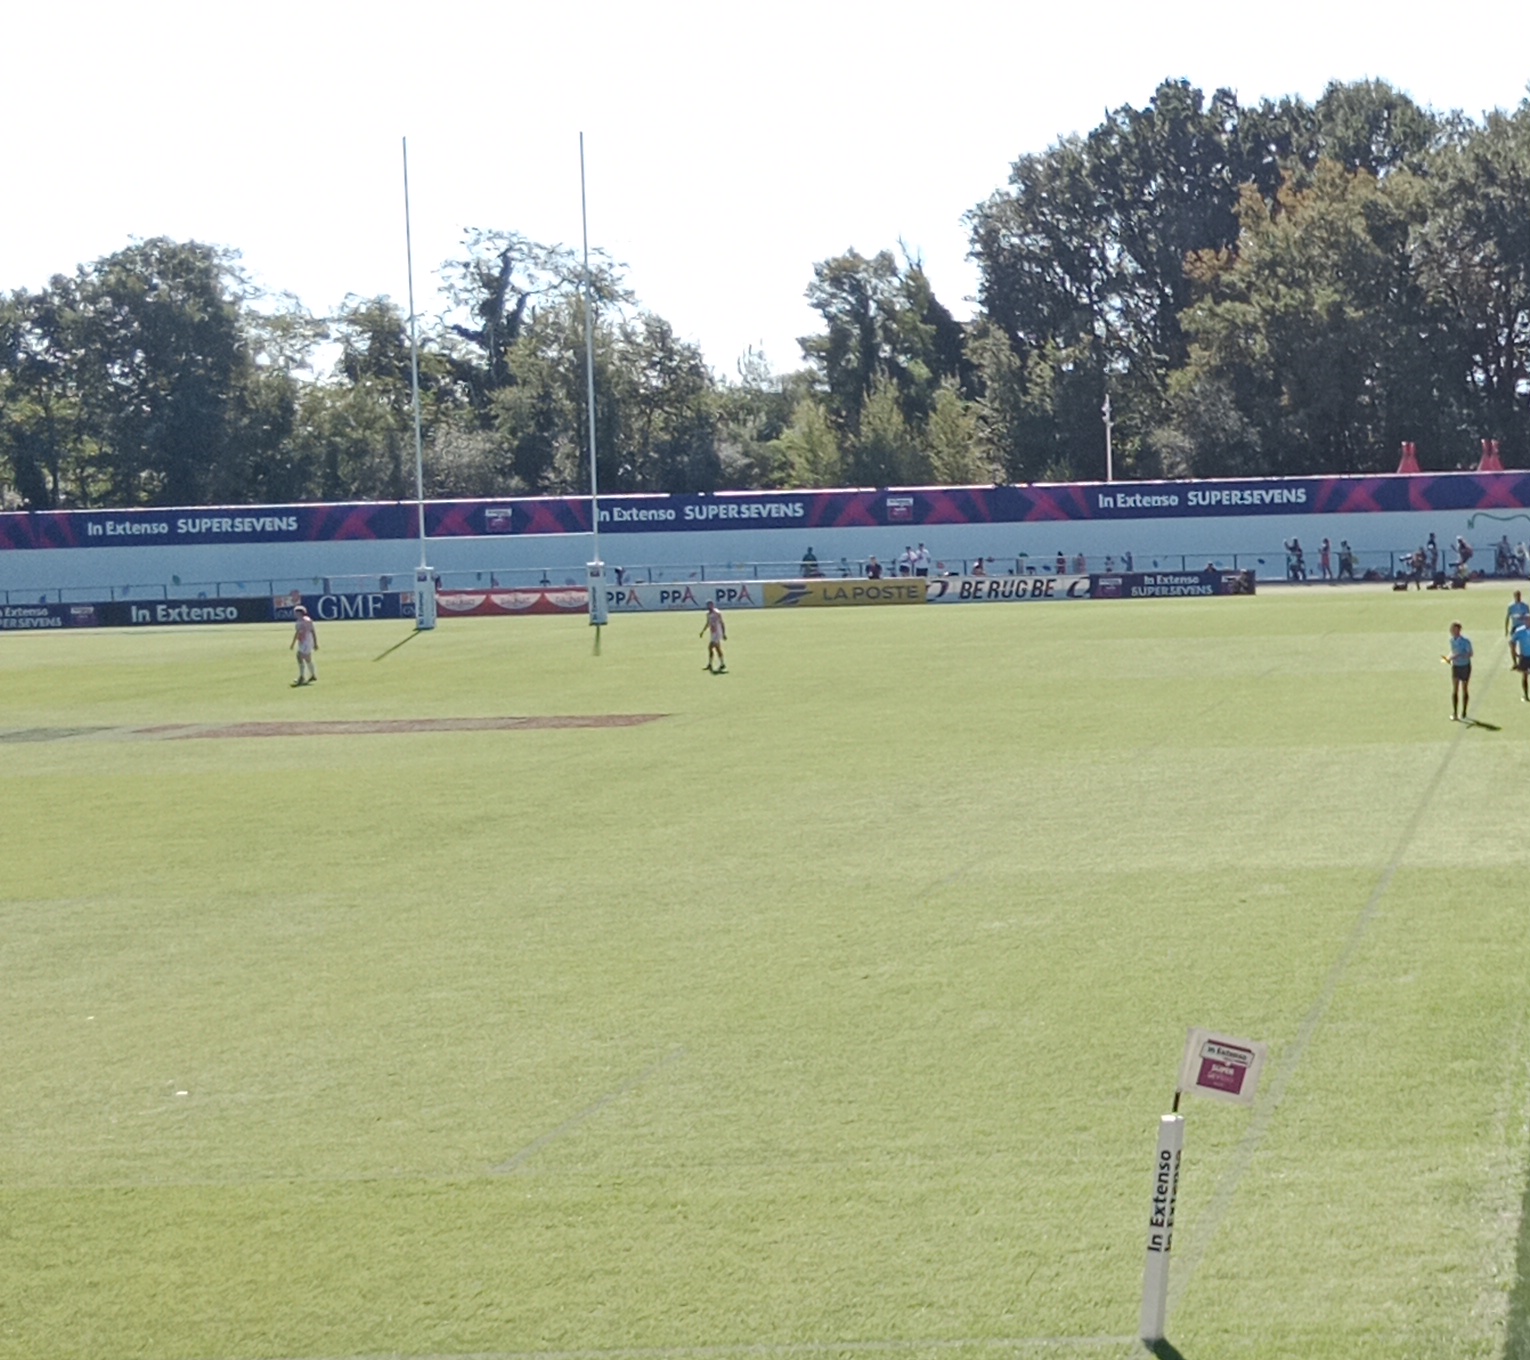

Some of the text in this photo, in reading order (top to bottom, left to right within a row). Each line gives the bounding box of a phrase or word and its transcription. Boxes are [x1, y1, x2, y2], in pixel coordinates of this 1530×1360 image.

[1099, 488, 1307, 509] In Extenso SUPERSEVENS
[613, 506, 676, 521] Extenso
[684, 503, 804, 520] SUPERSEVENS
[88, 517, 298, 536] In Extenso SUPERSEVENS
[660, 586, 698, 606] PPA
[716, 585, 754, 605] PPA
[823, 585, 919, 601] LA POSTE
[132, 604, 238, 623] In Extenso
[318, 594, 384, 620] GMF
[1147, 1150, 1171, 1252] In Extenso
